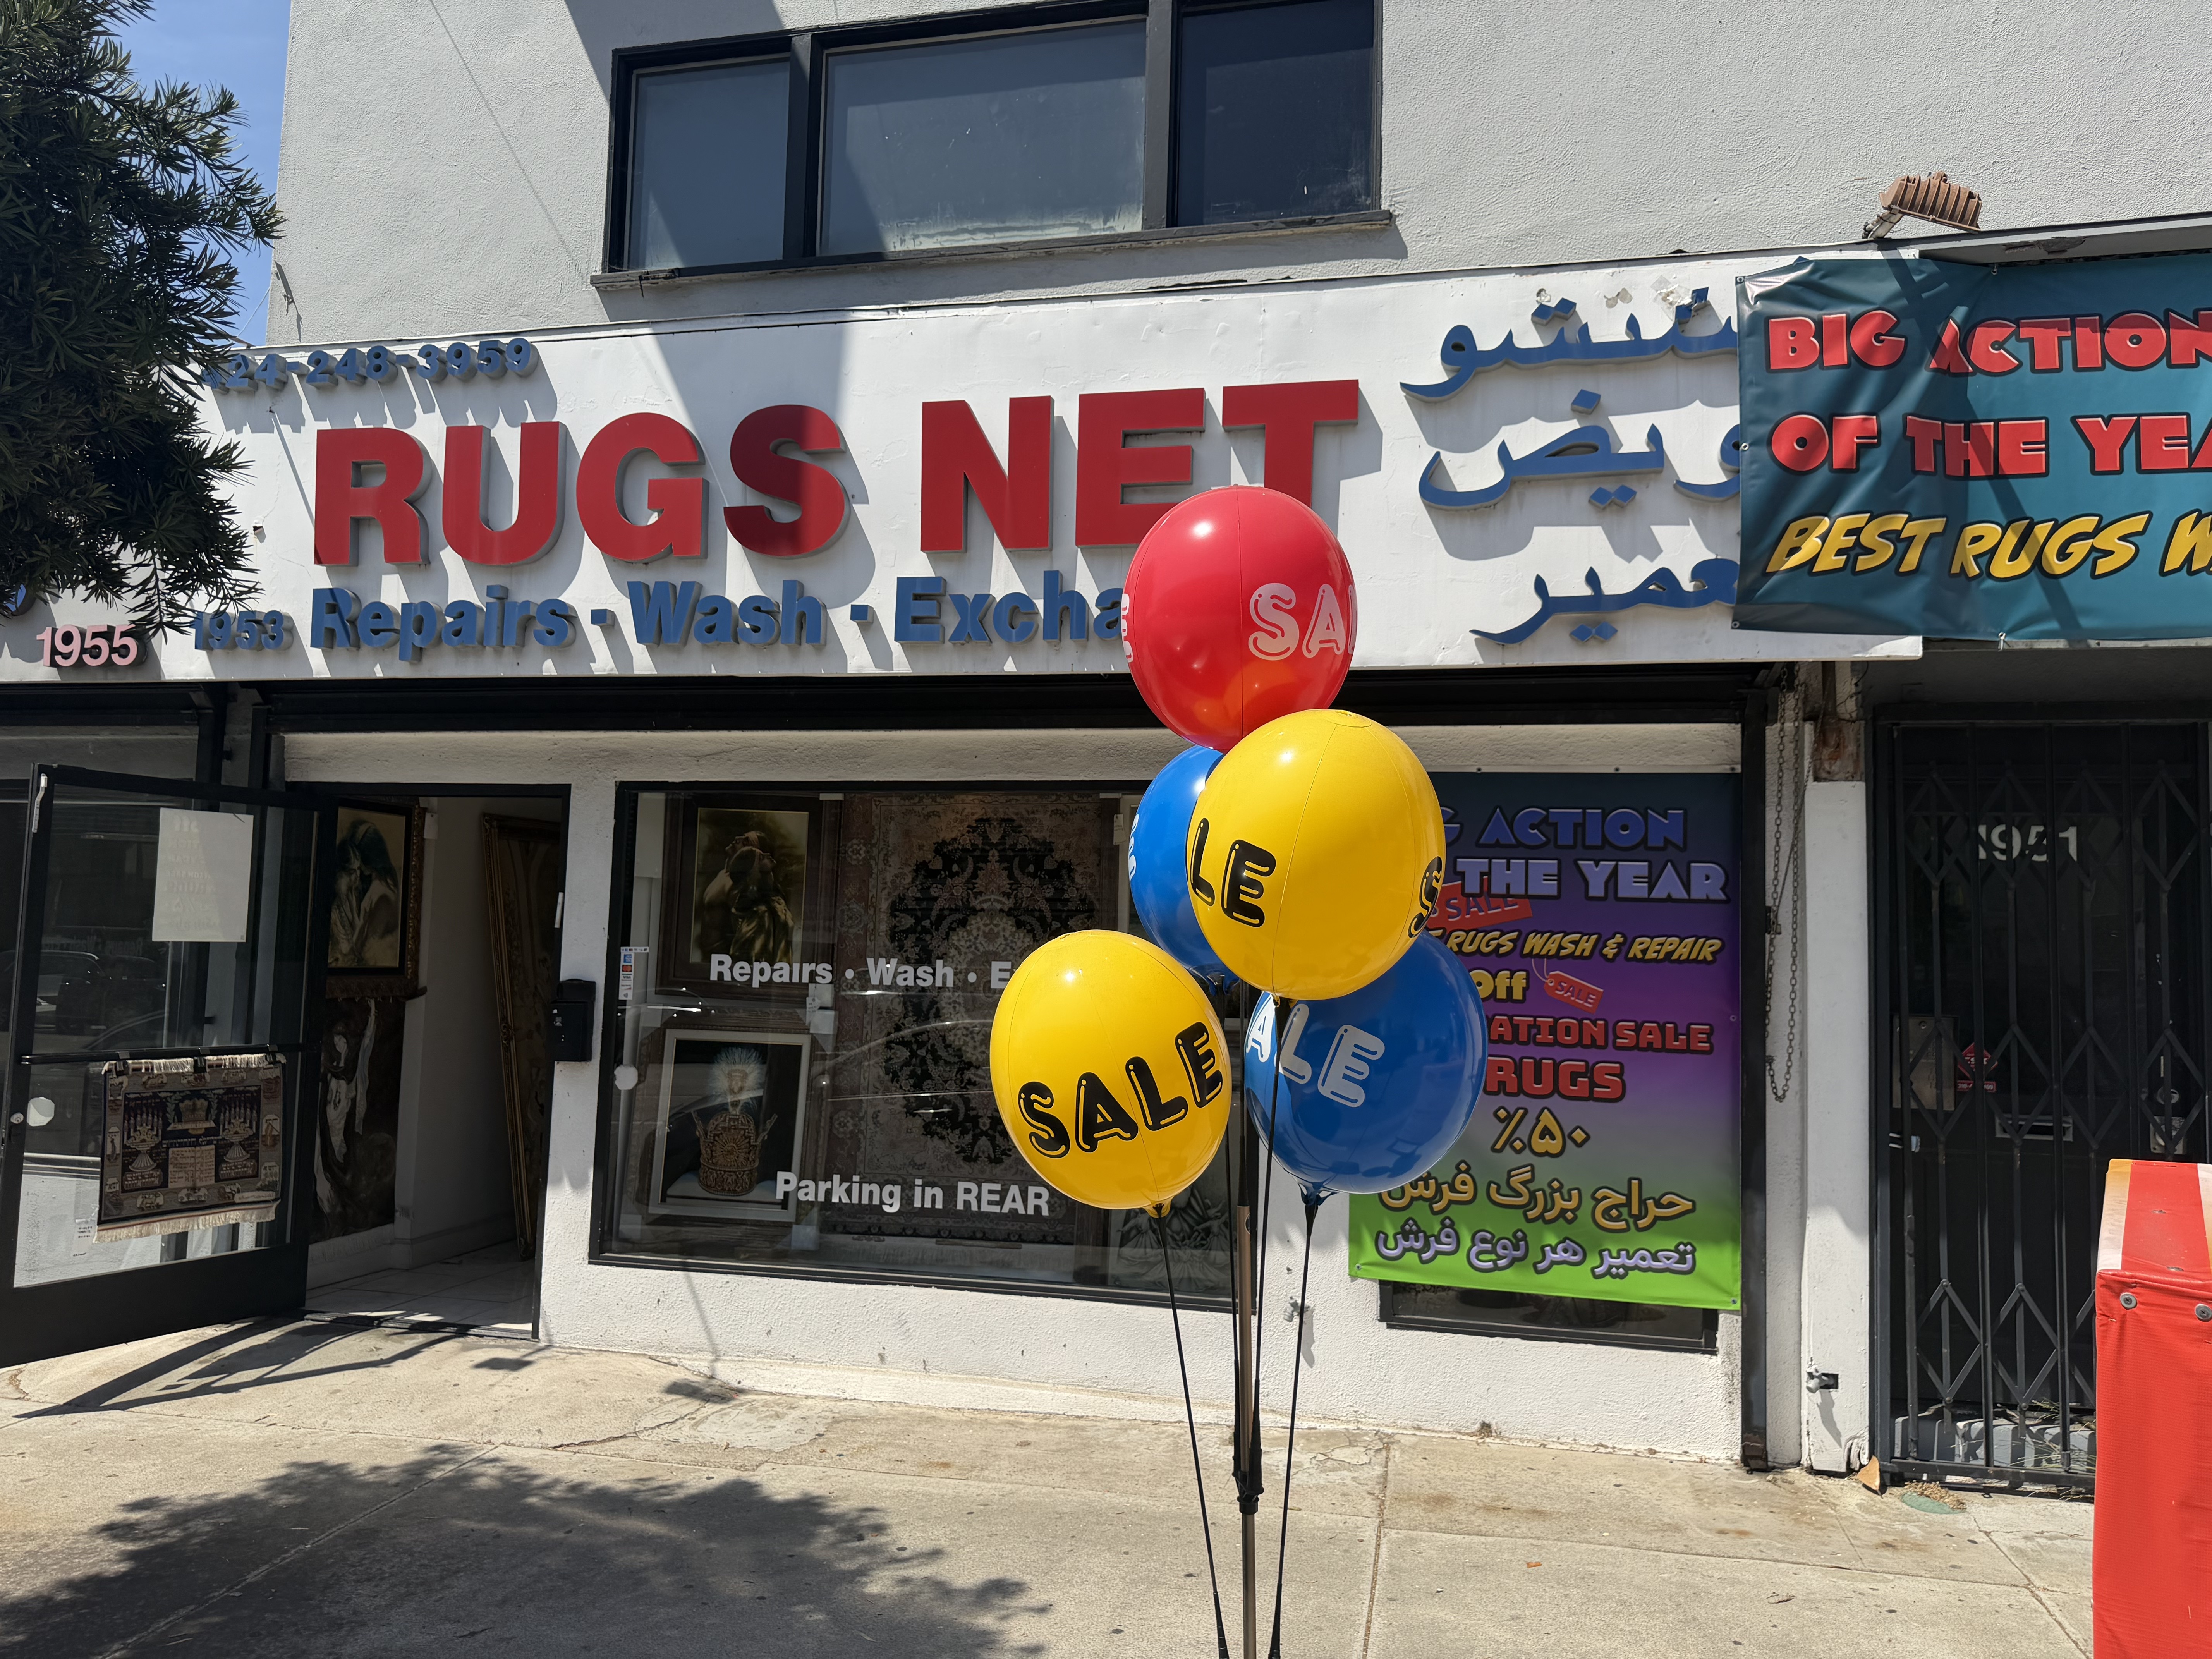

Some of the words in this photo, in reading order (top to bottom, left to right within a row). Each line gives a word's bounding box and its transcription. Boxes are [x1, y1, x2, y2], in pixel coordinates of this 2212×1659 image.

[1769, 310, 1905, 370] BIG
[1929, 309, 2212, 374] ACTION
[1771, 414, 1878, 472] OF
[1905, 415, 2047, 477] THE
[314, 404, 850, 565] RUGS
[920, 379, 1359, 553] NET
[1765, 513, 1947, 573] BEST
[1950, 513, 2151, 579] RUGS
[194, 610, 289, 651] 1953
[310, 585, 575, 663] Repairs
[627, 579, 828, 647] Wash
[894, 570, 1123, 646] Excha
[36, 624, 139, 667] 1955
[1479, 807, 1684, 848] ACTION
[1190, 818, 1276, 928] LE
[1456, 858, 1559, 896] THE
[1577, 860, 1727, 900] YEAR
[1446, 931, 1519, 954] RUGS
[1523, 931, 1599, 957] WASH
[1603, 933, 1623, 959] &
[1628, 935, 1722, 961] REPAIR
[710, 953, 833, 988] Repairs
[867, 957, 954, 987] Wash
[1469, 969, 1527, 1000] Off
[1555, 981, 1596, 1008] SALE
[1490, 1015, 1605, 1046] ATION
[1616, 1022, 1711, 1051] SALE
[1245, 1003, 1386, 1108] ALE
[1018, 1021, 1223, 1158] SALE
[1486, 1056, 1623, 1099] RUGS
[776, 1171, 901, 1213] Parking
[913, 1179, 943, 1209] in
[956, 1181, 1050, 1217] REAR
[1489, 1166, 1579, 1221] بزرگ
[1593, 1180, 1693, 1230] حراج
[1378, 1219, 1457, 1260] فرش
[1470, 1231, 1525, 1268] نوع
[1536, 1239, 1585, 1270] هر
[1594, 1242, 1695, 1279] تعمیر
